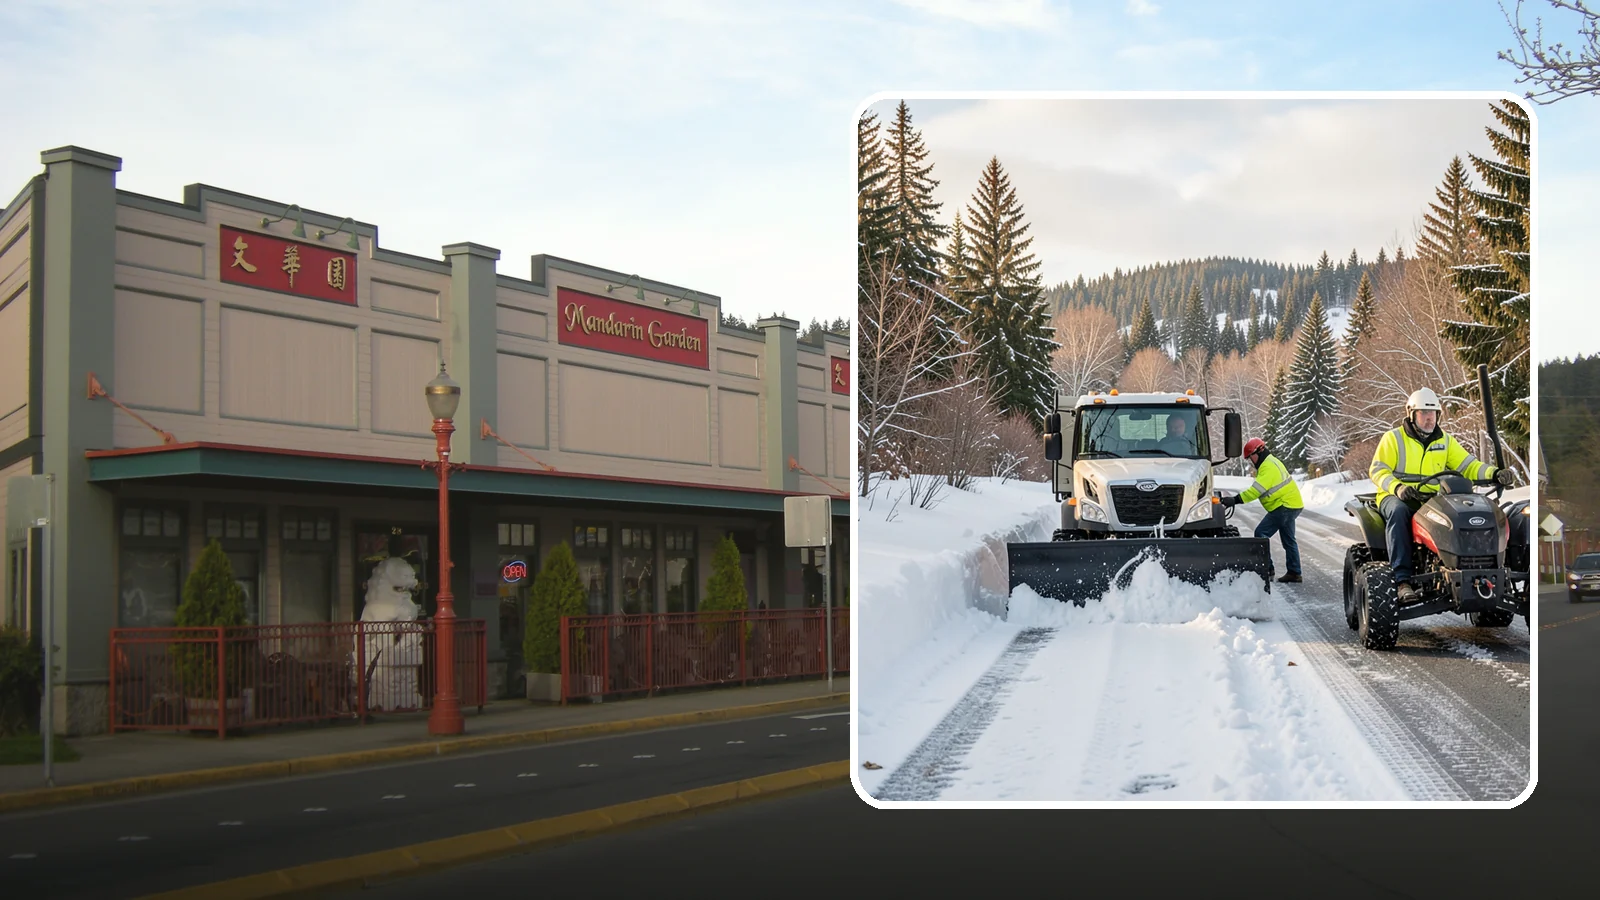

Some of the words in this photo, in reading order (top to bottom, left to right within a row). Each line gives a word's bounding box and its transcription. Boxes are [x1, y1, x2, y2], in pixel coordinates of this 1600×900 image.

[564, 302, 644, 341] Mandarin
[648, 320, 701, 352] Garden
[503, 565, 527, 578] OPEN
